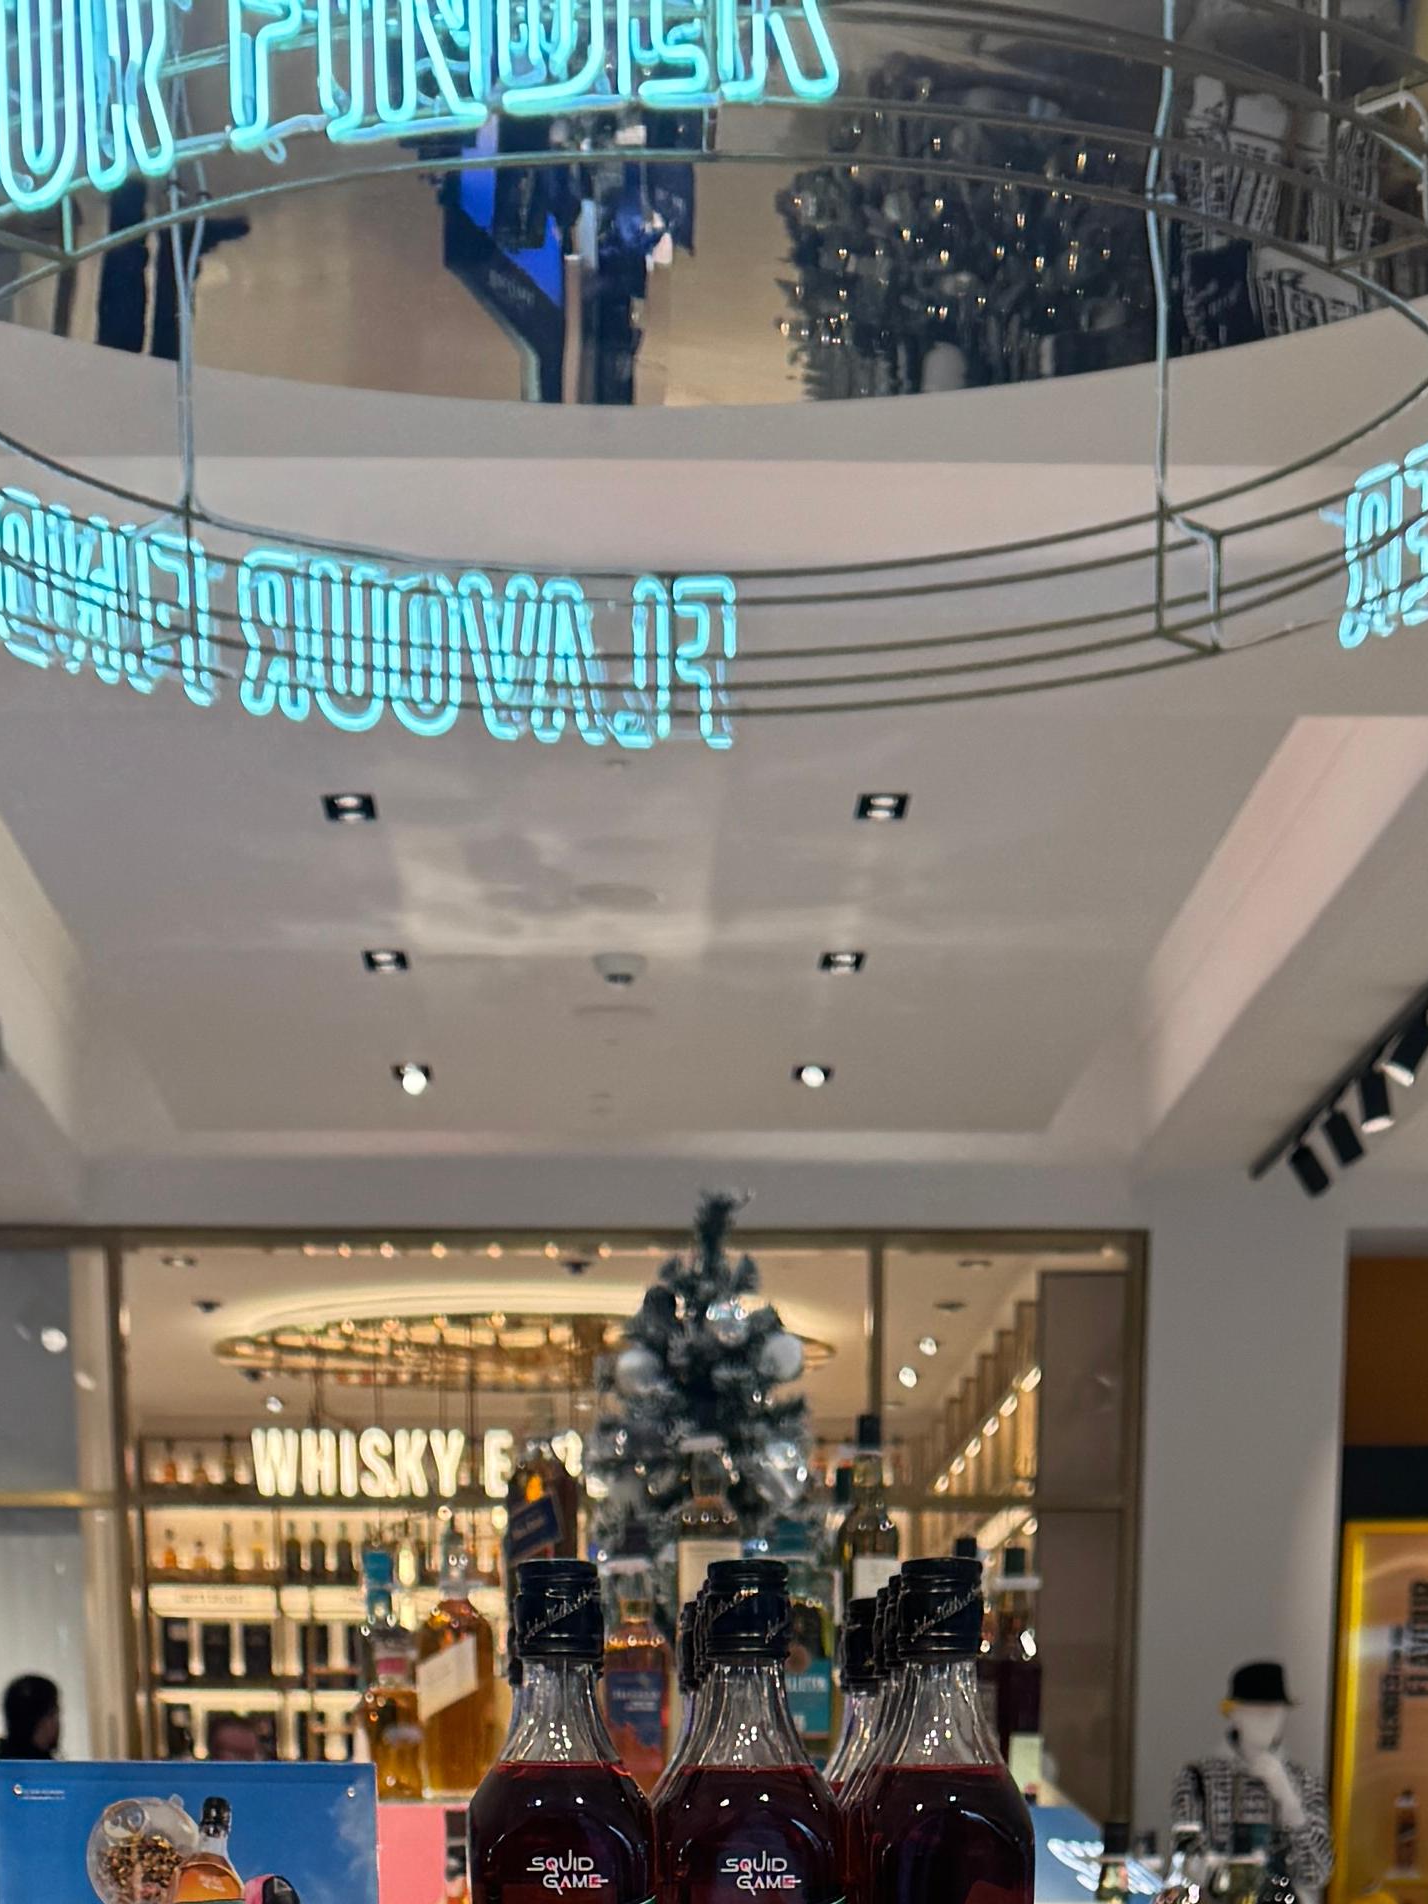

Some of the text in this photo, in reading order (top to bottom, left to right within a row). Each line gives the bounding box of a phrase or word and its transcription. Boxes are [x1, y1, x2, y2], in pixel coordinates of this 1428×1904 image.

[251, 1427, 467, 1498] WHISKY
[526, 1849, 594, 1876] SQUID
[720, 1850, 788, 1877] SQUID
[543, 1874, 609, 1895] GAME
[736, 1874, 802, 1896] GAME
